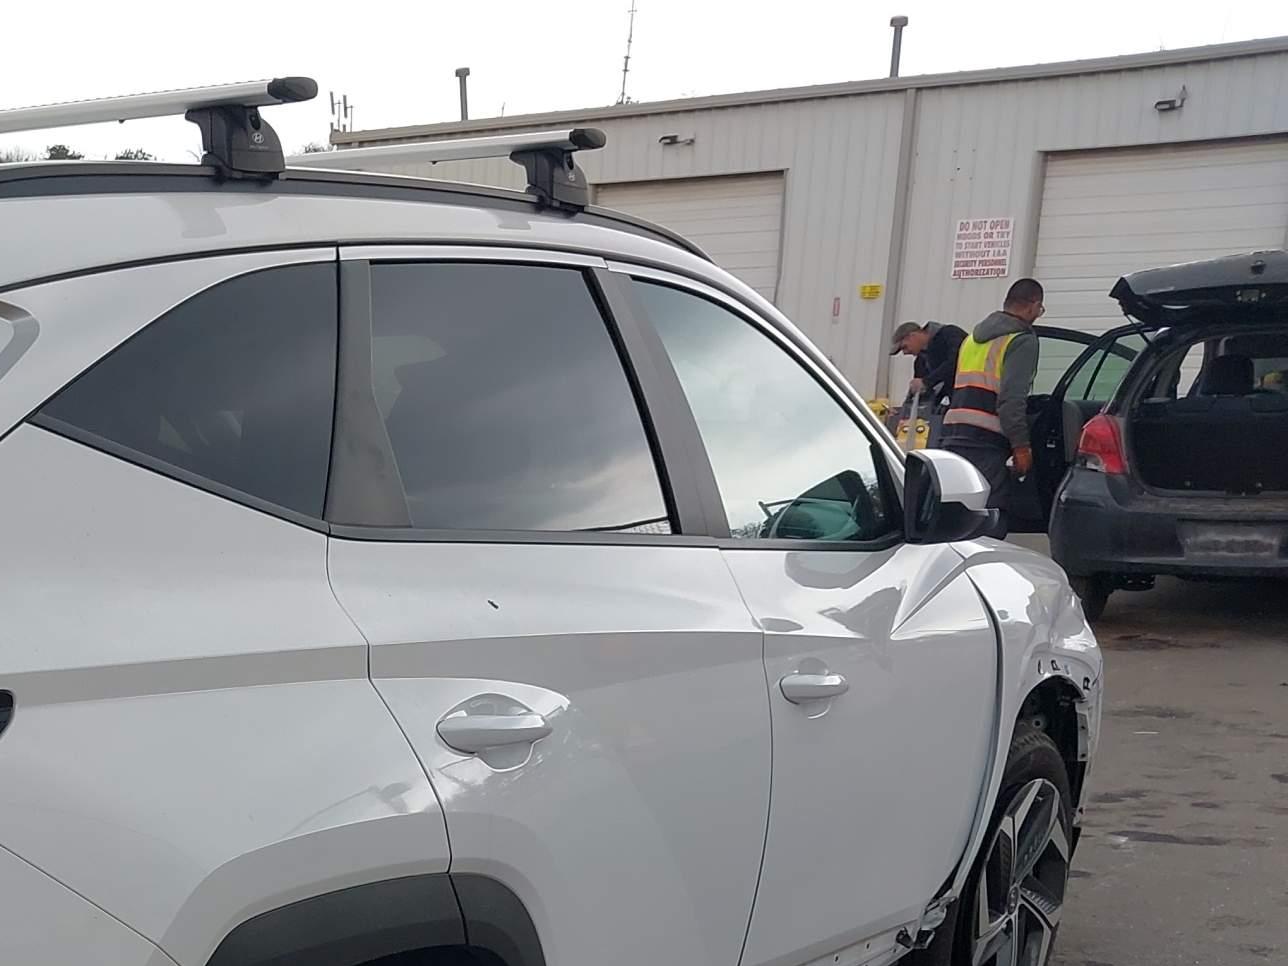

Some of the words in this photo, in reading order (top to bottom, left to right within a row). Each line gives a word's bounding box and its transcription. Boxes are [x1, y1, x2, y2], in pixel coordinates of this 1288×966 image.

[959, 221, 970, 231] DO
[972, 220, 988, 231] NOT
[989, 219, 1010, 230] OPEN
[983, 231, 994, 239] OR
[996, 231, 1011, 239] TRY
[952, 268, 1006, 277] AUTHORIZATION
